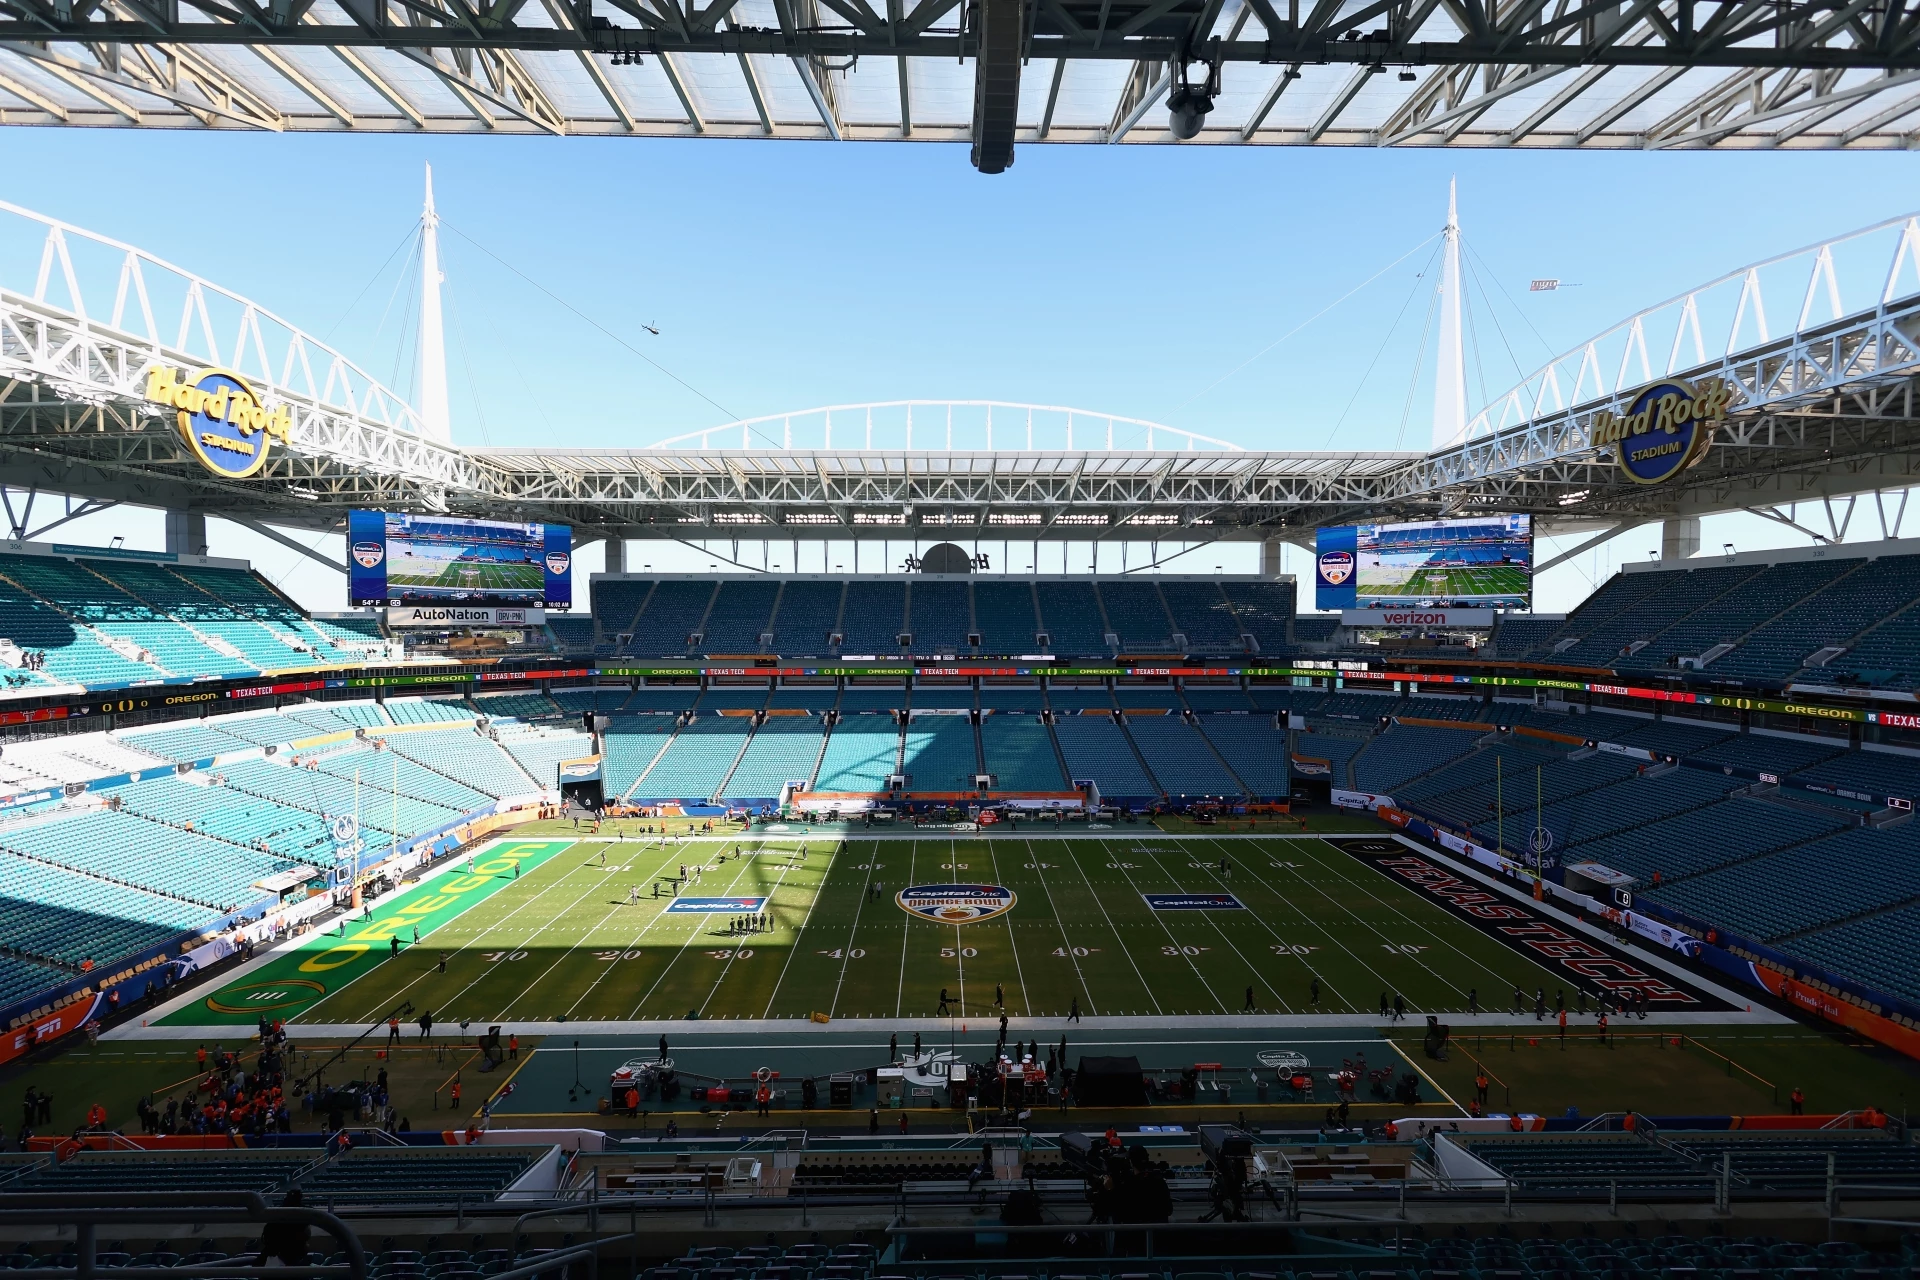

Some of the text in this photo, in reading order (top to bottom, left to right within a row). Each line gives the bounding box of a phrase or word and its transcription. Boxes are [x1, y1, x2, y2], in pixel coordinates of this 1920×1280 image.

[145, 365, 293, 445] Hard Rock
[1591, 378, 1730, 446] Hard Rock
[201, 433, 254, 455] STADIUM
[1631, 442, 1682, 462] STADIUM
[412, 608, 489, 620] AutoNation
[1383, 611, 1446, 624] verizon
[415, 675, 466, 683] OREGON
[1537, 680, 1578, 688] OREGON
[1594, 684, 1612, 694] TEXAS
[1613, 686, 1628, 695] TECH
[165, 693, 216, 705] OREGON
[236, 687, 256, 698] TEXAS
[258, 686, 273, 695] TECH
[1785, 705, 1852, 719] OREGON
[1868, 714, 1876, 722] VS
[908, 898, 1004, 907] ORANGE BOWL
[1623, 893, 1628, 904] 0
[298, 843, 550, 972] OREGON
[1377, 856, 1702, 1003] TEXAS TECH
[715, 949, 754, 961] 30
[827, 948, 866, 959] 40
[940, 947, 978, 958] 50
[1052, 946, 1088, 957] 40
[1161, 945, 1200, 956] 30
[1275, 944, 1310, 955] 20
[1381, 944, 1420, 954] 10
[489, 950, 528, 962] 10
[600, 949, 641, 962] 20
[14, 1018, 61, 1049] EPN
